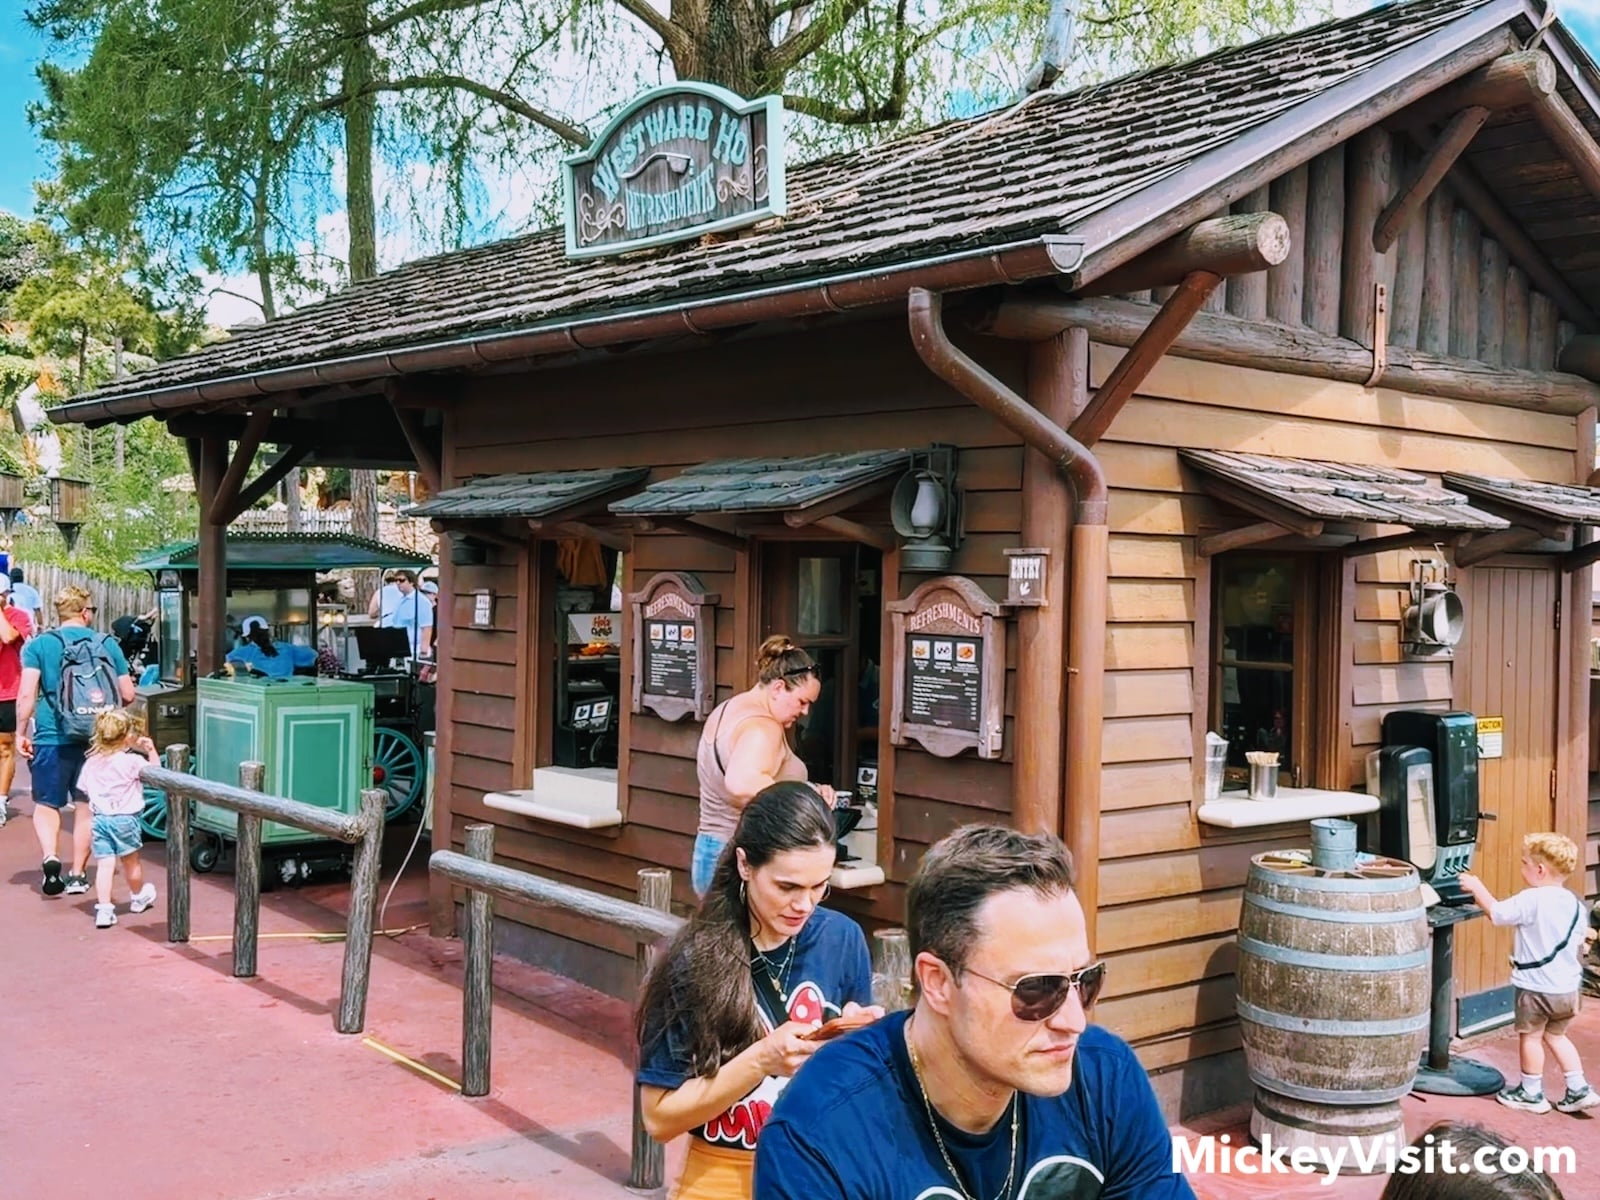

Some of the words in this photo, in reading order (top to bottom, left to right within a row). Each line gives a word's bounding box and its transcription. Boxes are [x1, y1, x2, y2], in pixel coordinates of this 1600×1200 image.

[592, 104, 714, 201] WESTWARD
[712, 110, 748, 166] HO
[625, 163, 717, 231] REFRESHMENTS
[1011, 558, 1041, 580] ENTRY
[646, 592, 696, 619] REFRESHMENTS
[910, 601, 981, 634] REFRESHMENTS
[1479, 720, 1501, 730] CAUTION
